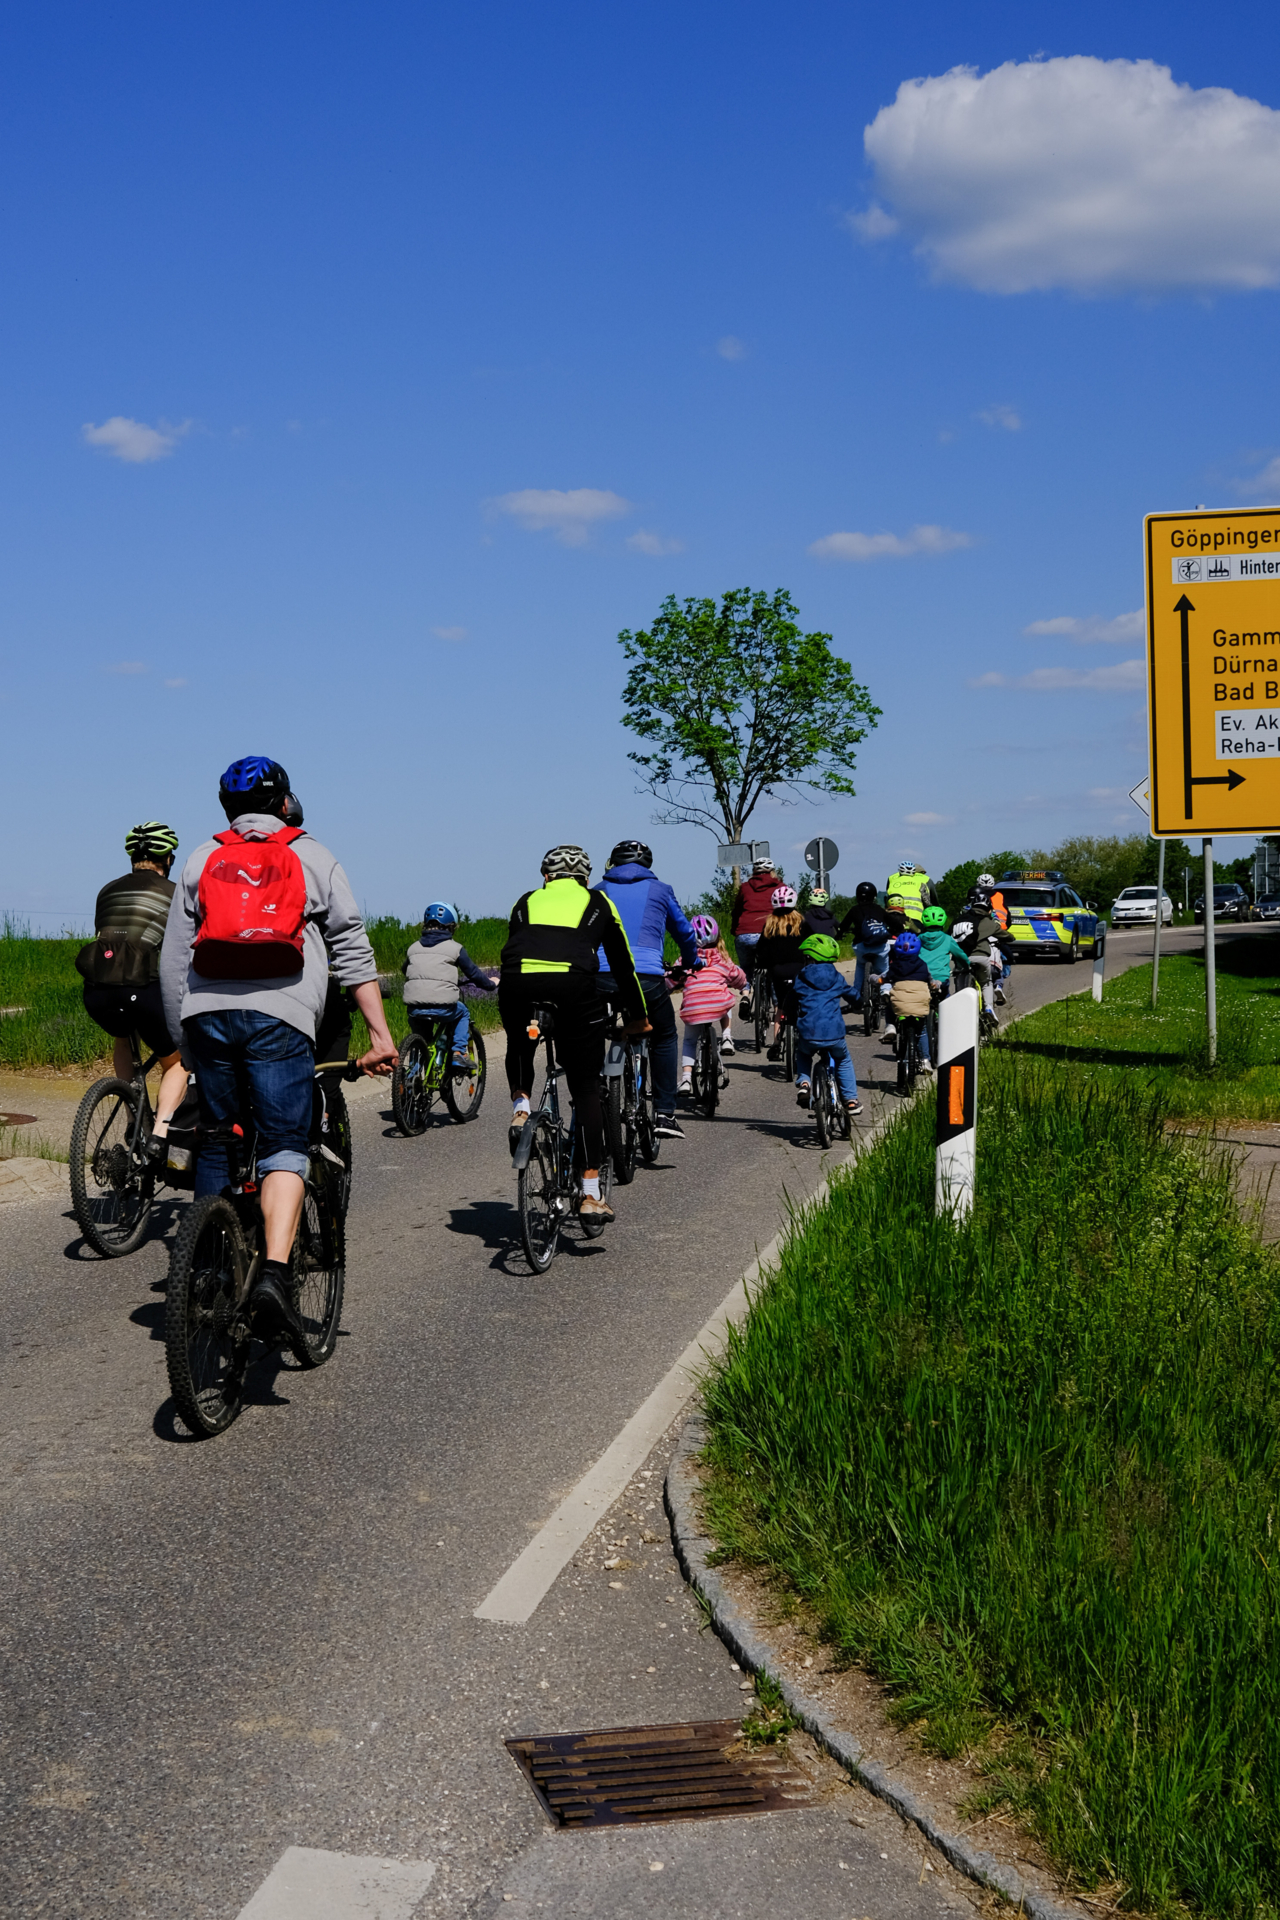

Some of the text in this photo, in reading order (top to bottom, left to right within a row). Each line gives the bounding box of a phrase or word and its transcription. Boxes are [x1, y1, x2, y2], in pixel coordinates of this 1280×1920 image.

[1213, 629, 1280, 647] Gamm
[1213, 655, 1278, 674] Dürna
[1214, 681, 1279, 701] Bad B
[1221, 714, 1279, 731] Ev. Ak
[1221, 737, 1280, 754] Reha-
[952, 921, 974, 937] NIKE
